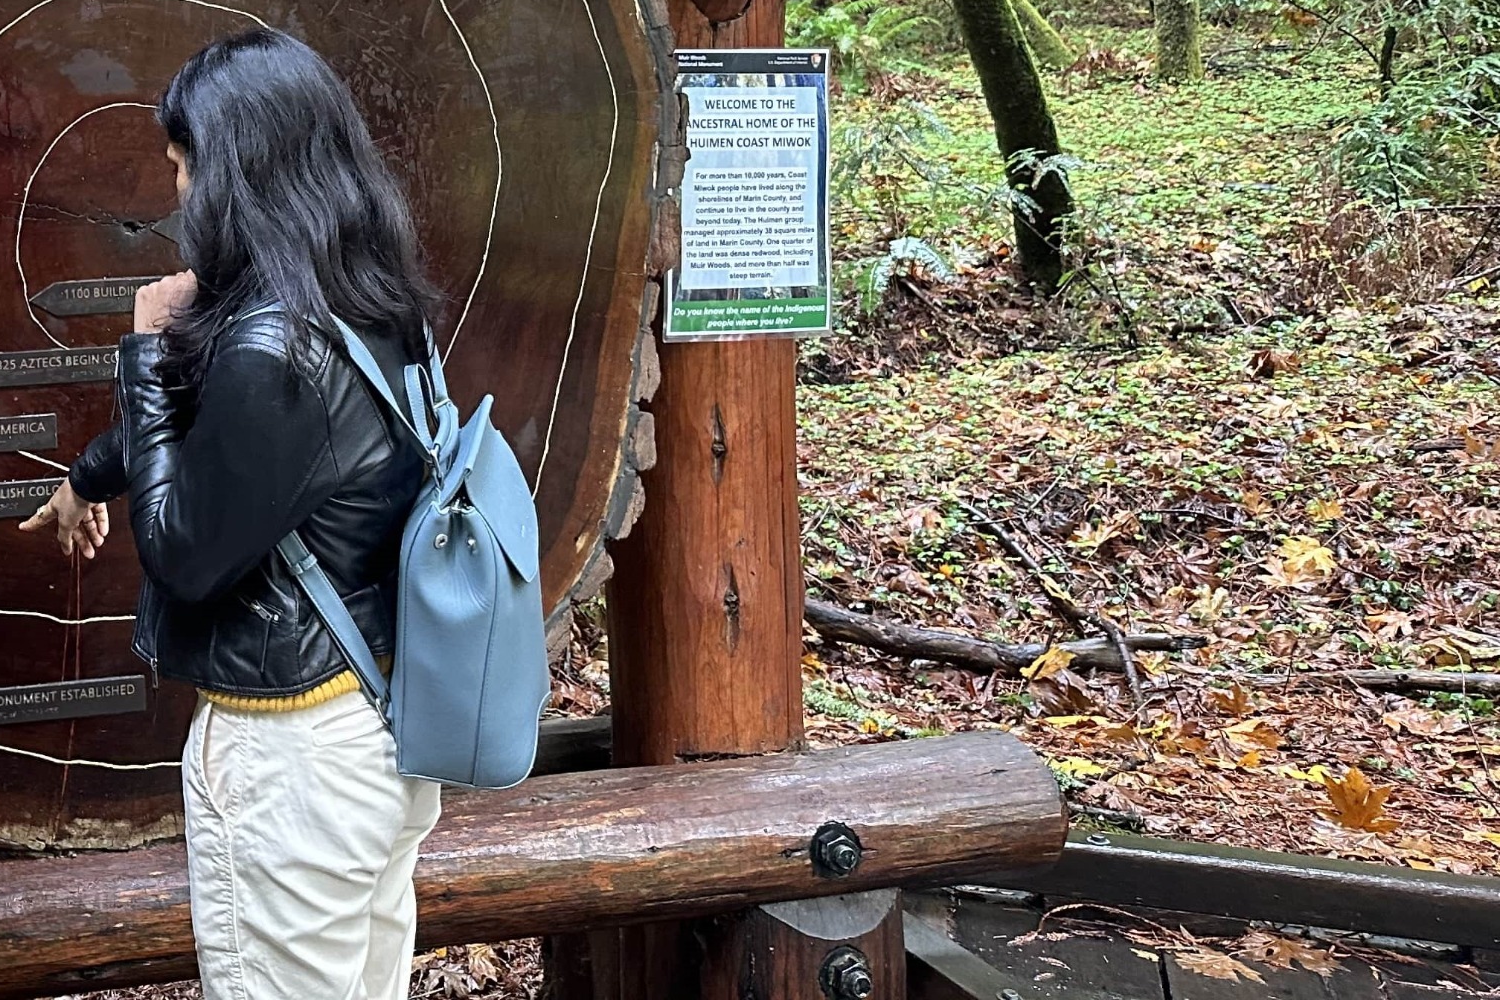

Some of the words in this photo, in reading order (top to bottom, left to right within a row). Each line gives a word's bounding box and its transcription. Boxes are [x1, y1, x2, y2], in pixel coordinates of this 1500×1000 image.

[705, 100, 757, 109] WELCOME
[761, 100, 773, 108] TO
[777, 99, 795, 108] THE
[687, 119, 743, 128] ANCESTRAL
[746, 119, 777, 128] HOME
[781, 119, 794, 127] OF
[797, 119, 816, 127] THE
[690, 138, 733, 147] HUIMEN
[736, 138, 769, 147] COAST
[772, 137, 811, 147] MIWOK
[684, 229, 714, 237] managed
[717, 228, 762, 236] approximately
[64, 287, 90, 299] 1100
[94, 286, 139, 298] BUILDIN
[674, 308, 685, 316] Do
[687, 308, 701, 317] you
[704, 307, 725, 315] know
[785, 304, 825, 313] Indigenous
[707, 318, 734, 328] people
[736, 318, 758, 326] where
[760, 318, 774, 326] you
[20, 356, 62, 369] AZTECS
[65, 354, 100, 367] BEGIN
[28, 484, 60, 497] COLO
[60, 684, 136, 701] ESTABLISHED
